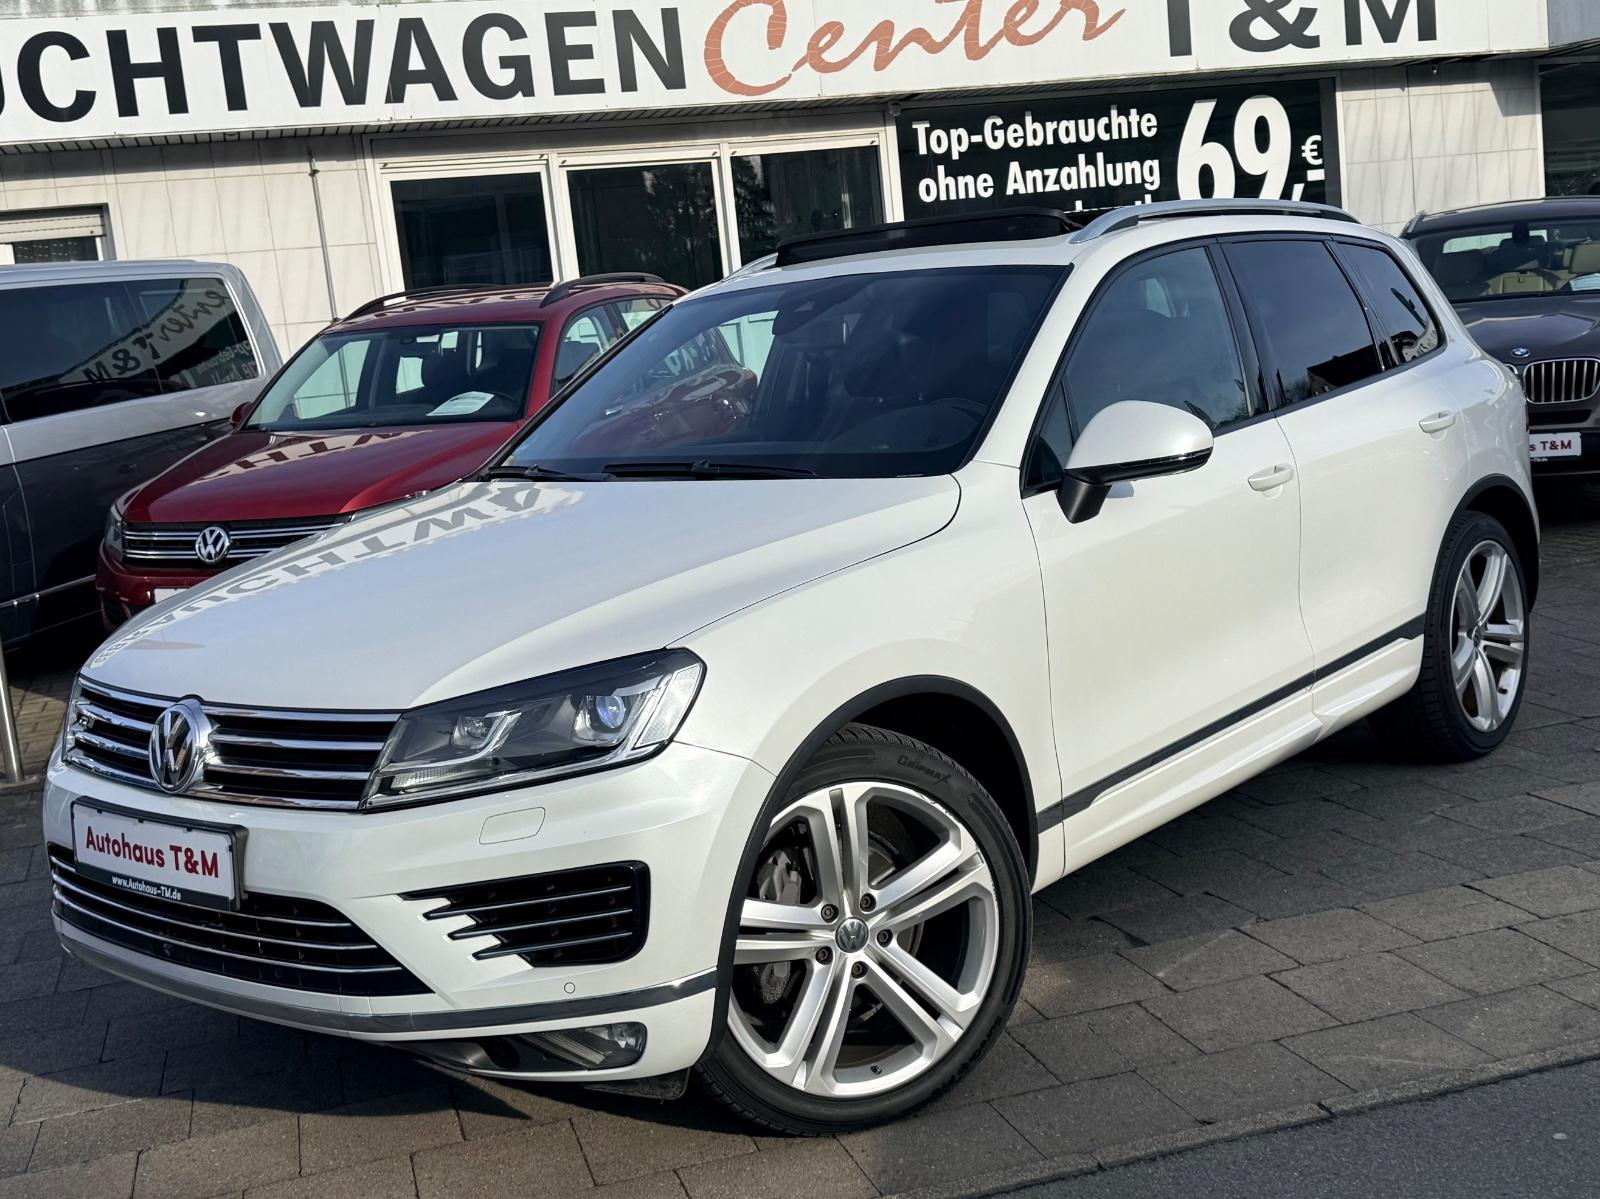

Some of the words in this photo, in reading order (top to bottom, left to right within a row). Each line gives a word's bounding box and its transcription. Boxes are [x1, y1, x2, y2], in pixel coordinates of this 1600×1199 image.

[0, 8, 687, 123] CHTWAGEN
[704, 0, 1126, 97] Center
[912, 104, 1158, 160] Top-Gebrauchte
[918, 164, 994, 202] ohne
[1006, 152, 1160, 196] Anzahlung
[1540, 440, 1572, 451] T&M
[86, 826, 165, 868] Autohaus
[169, 844, 219, 878] T&M
[112, 875, 182, 901] www.Autohaus-TM.de
